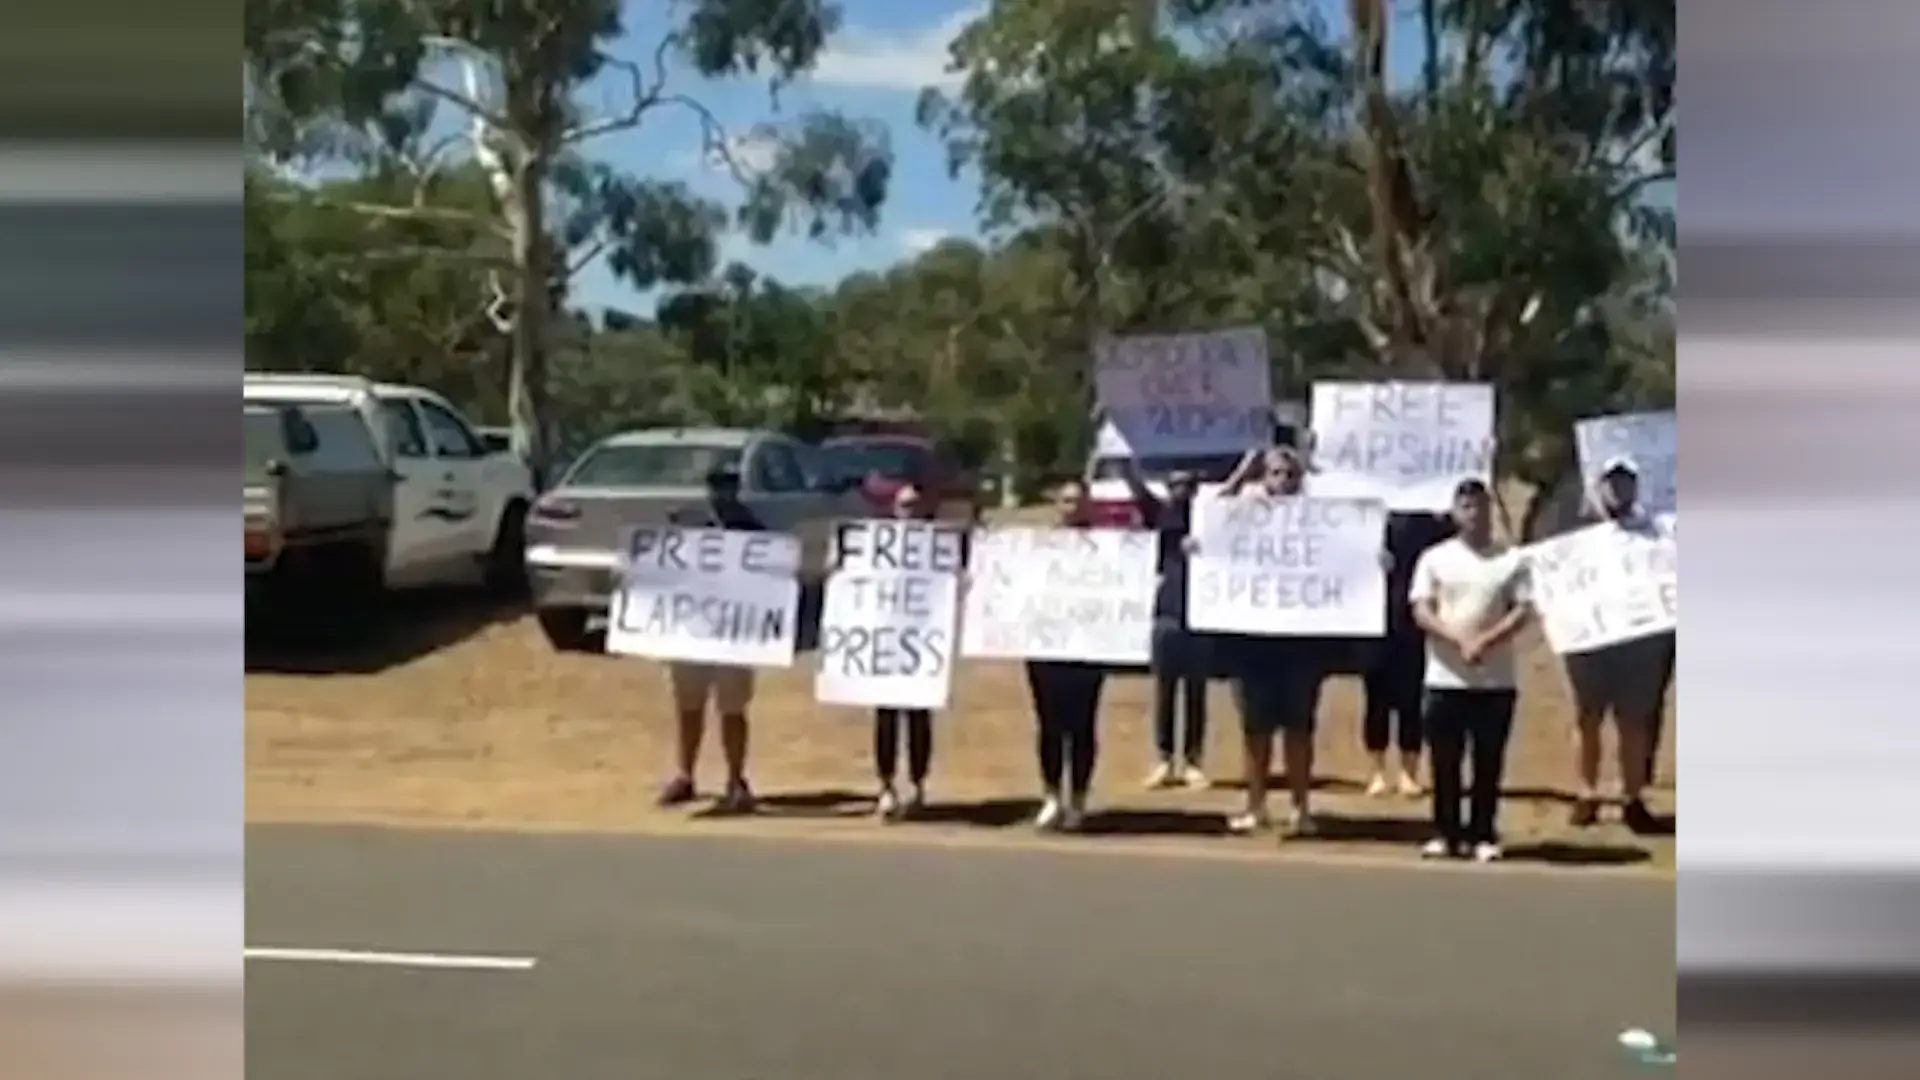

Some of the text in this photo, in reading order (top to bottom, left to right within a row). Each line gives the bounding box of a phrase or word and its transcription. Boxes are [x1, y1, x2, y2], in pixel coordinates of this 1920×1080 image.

[1333, 386, 1464, 426] FREE
[630, 527, 774, 572] FREE
[837, 524, 954, 572] FREE
[1229, 534, 1327, 567] FREE
[850, 577, 931, 617] THE
[1198, 571, 1345, 610] SPEECH
[617, 585, 785, 644] LAPSHIN
[823, 626, 946, 678] PRESS
